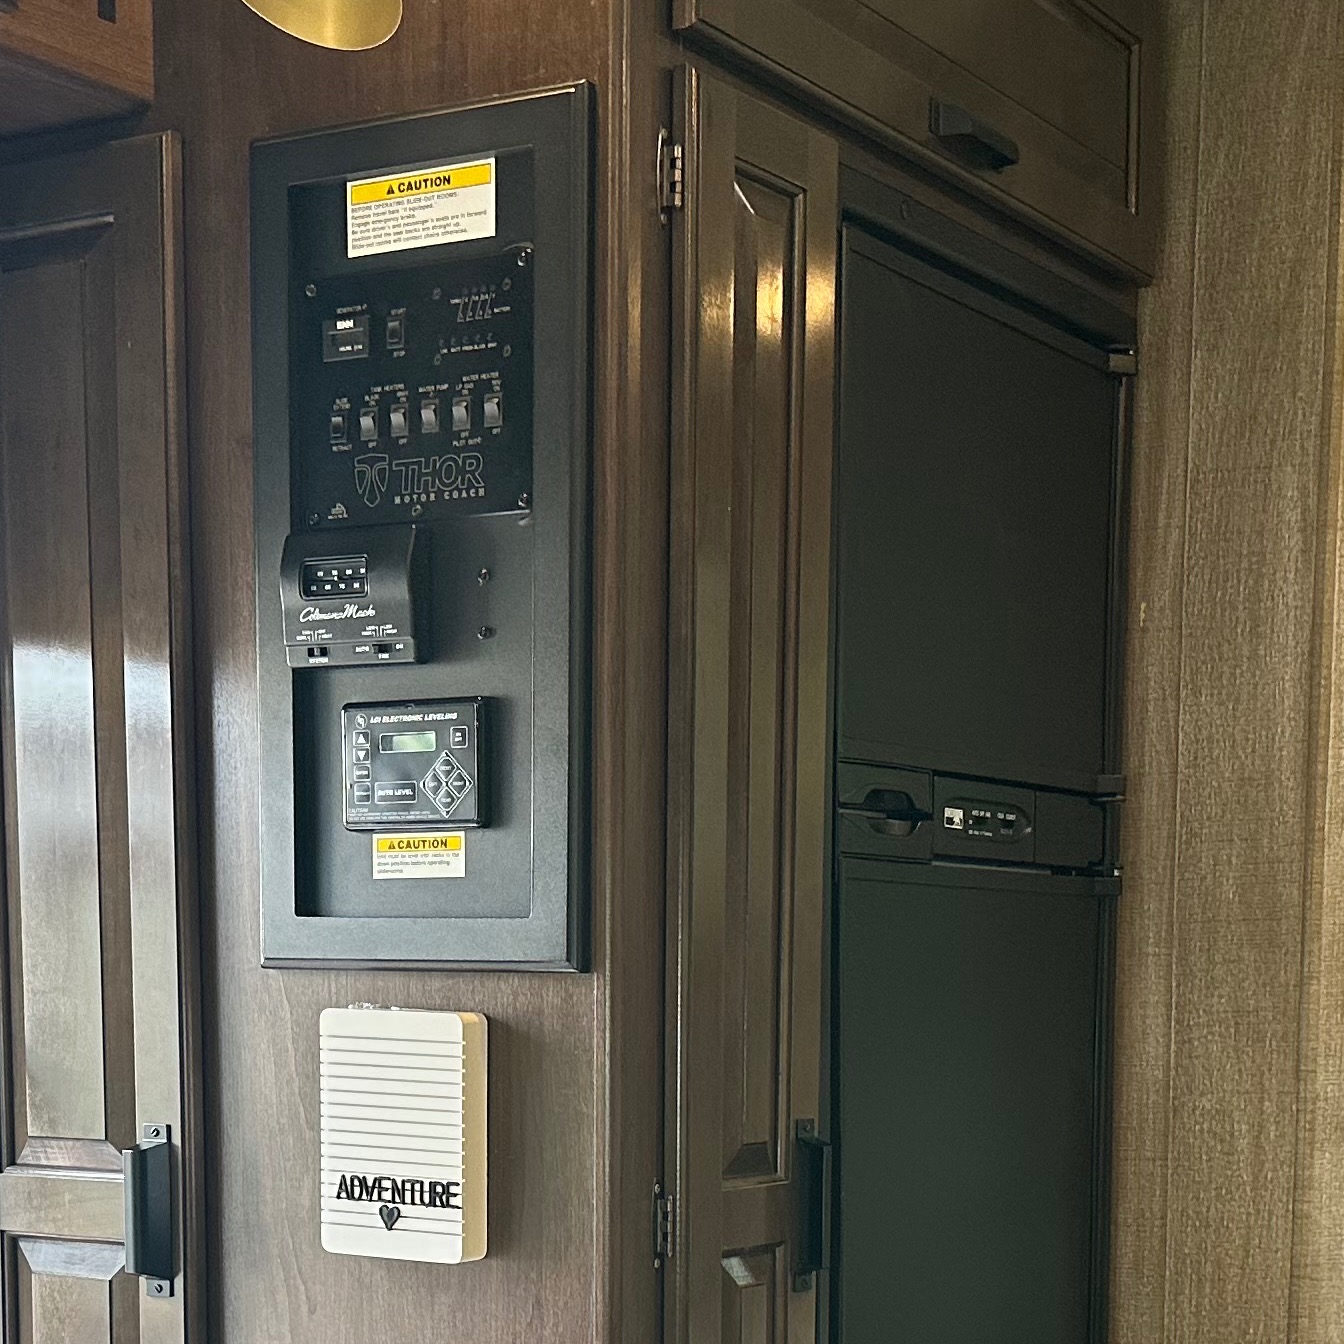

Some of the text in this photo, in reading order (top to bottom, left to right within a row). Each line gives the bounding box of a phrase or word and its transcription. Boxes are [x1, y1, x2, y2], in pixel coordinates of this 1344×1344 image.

[397, 174, 451, 193] CAUTION
[392, 452, 485, 494] THOR
[394, 488, 485, 504] MOTOR COACH
[397, 838, 448, 850] CAUTION
[335, 1173, 463, 1210] ADVENTURE
